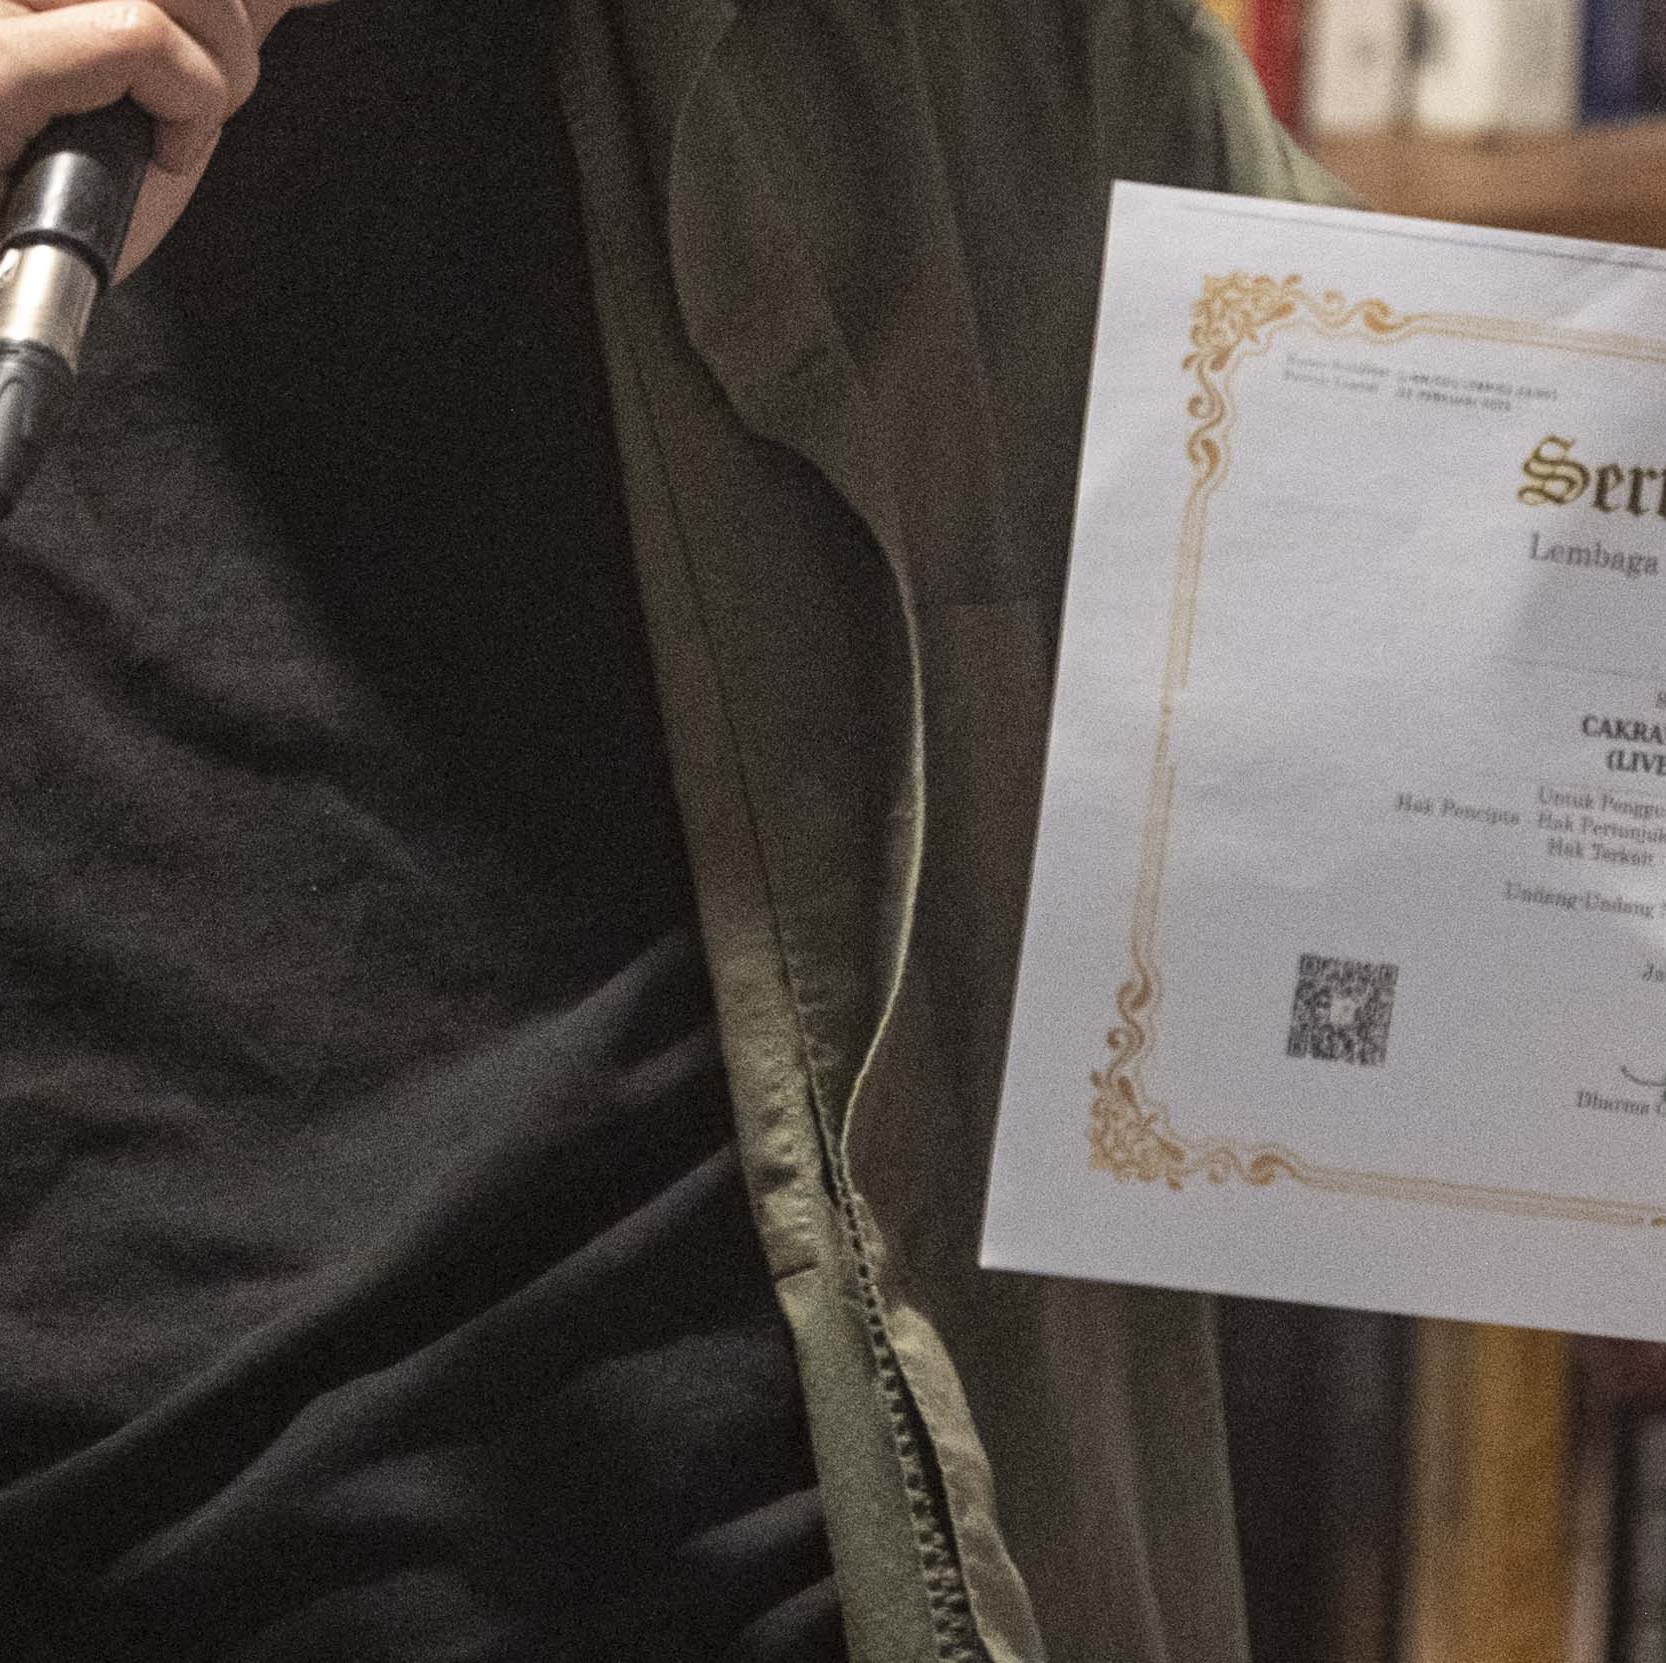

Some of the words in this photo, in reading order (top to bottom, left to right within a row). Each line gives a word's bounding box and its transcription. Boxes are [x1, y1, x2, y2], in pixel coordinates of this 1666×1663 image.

[1530, 534, 1659, 580] Lembaga
[1538, 788, 1594, 809] Untuk
[1396, 794, 1434, 814] Hak
[1441, 800, 1519, 827] Pencipta
[1538, 811, 1574, 831] Hak
[1547, 838, 1584, 858] Hak
[1577, 1091, 1649, 1114] Dharma
